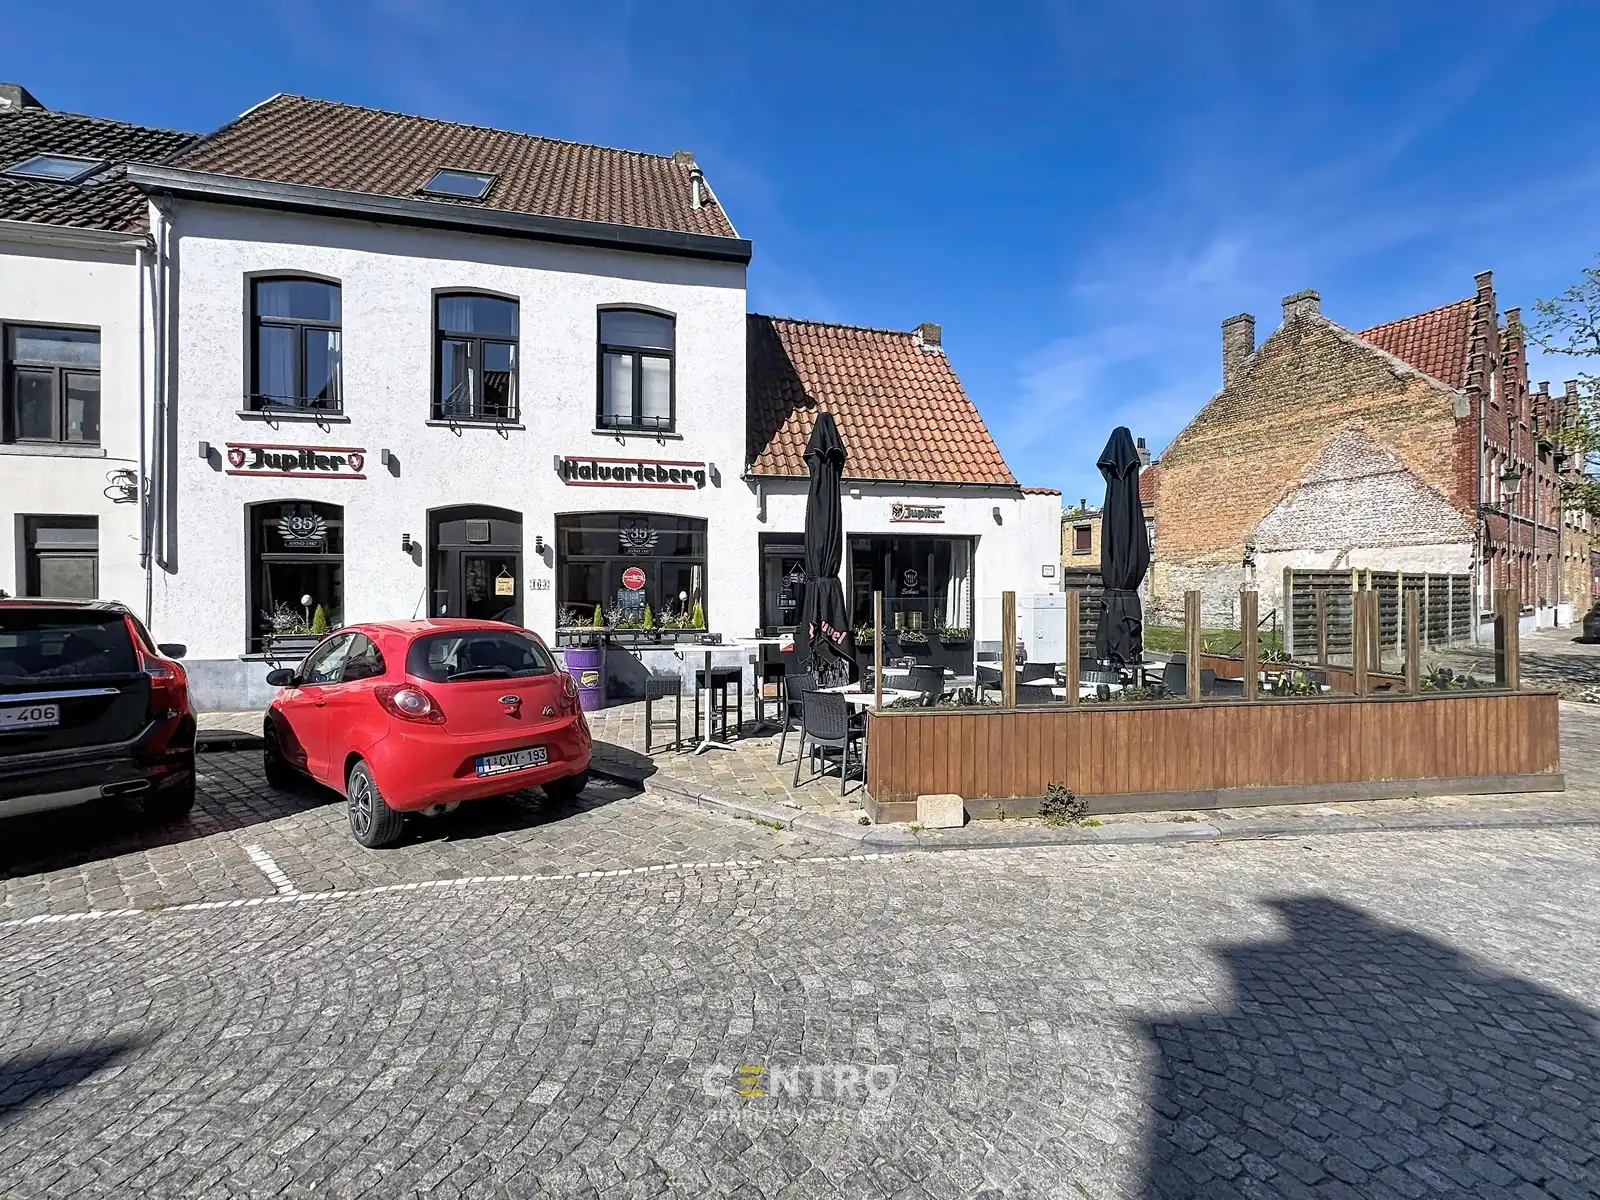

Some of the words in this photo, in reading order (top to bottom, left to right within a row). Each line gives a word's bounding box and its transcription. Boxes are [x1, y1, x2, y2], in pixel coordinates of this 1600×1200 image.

[564, 460, 706, 490] Kalvarieberg
[292, 516, 313, 530] 35
[630, 527, 648, 539] 35
[0, 706, 55, 722] -406
